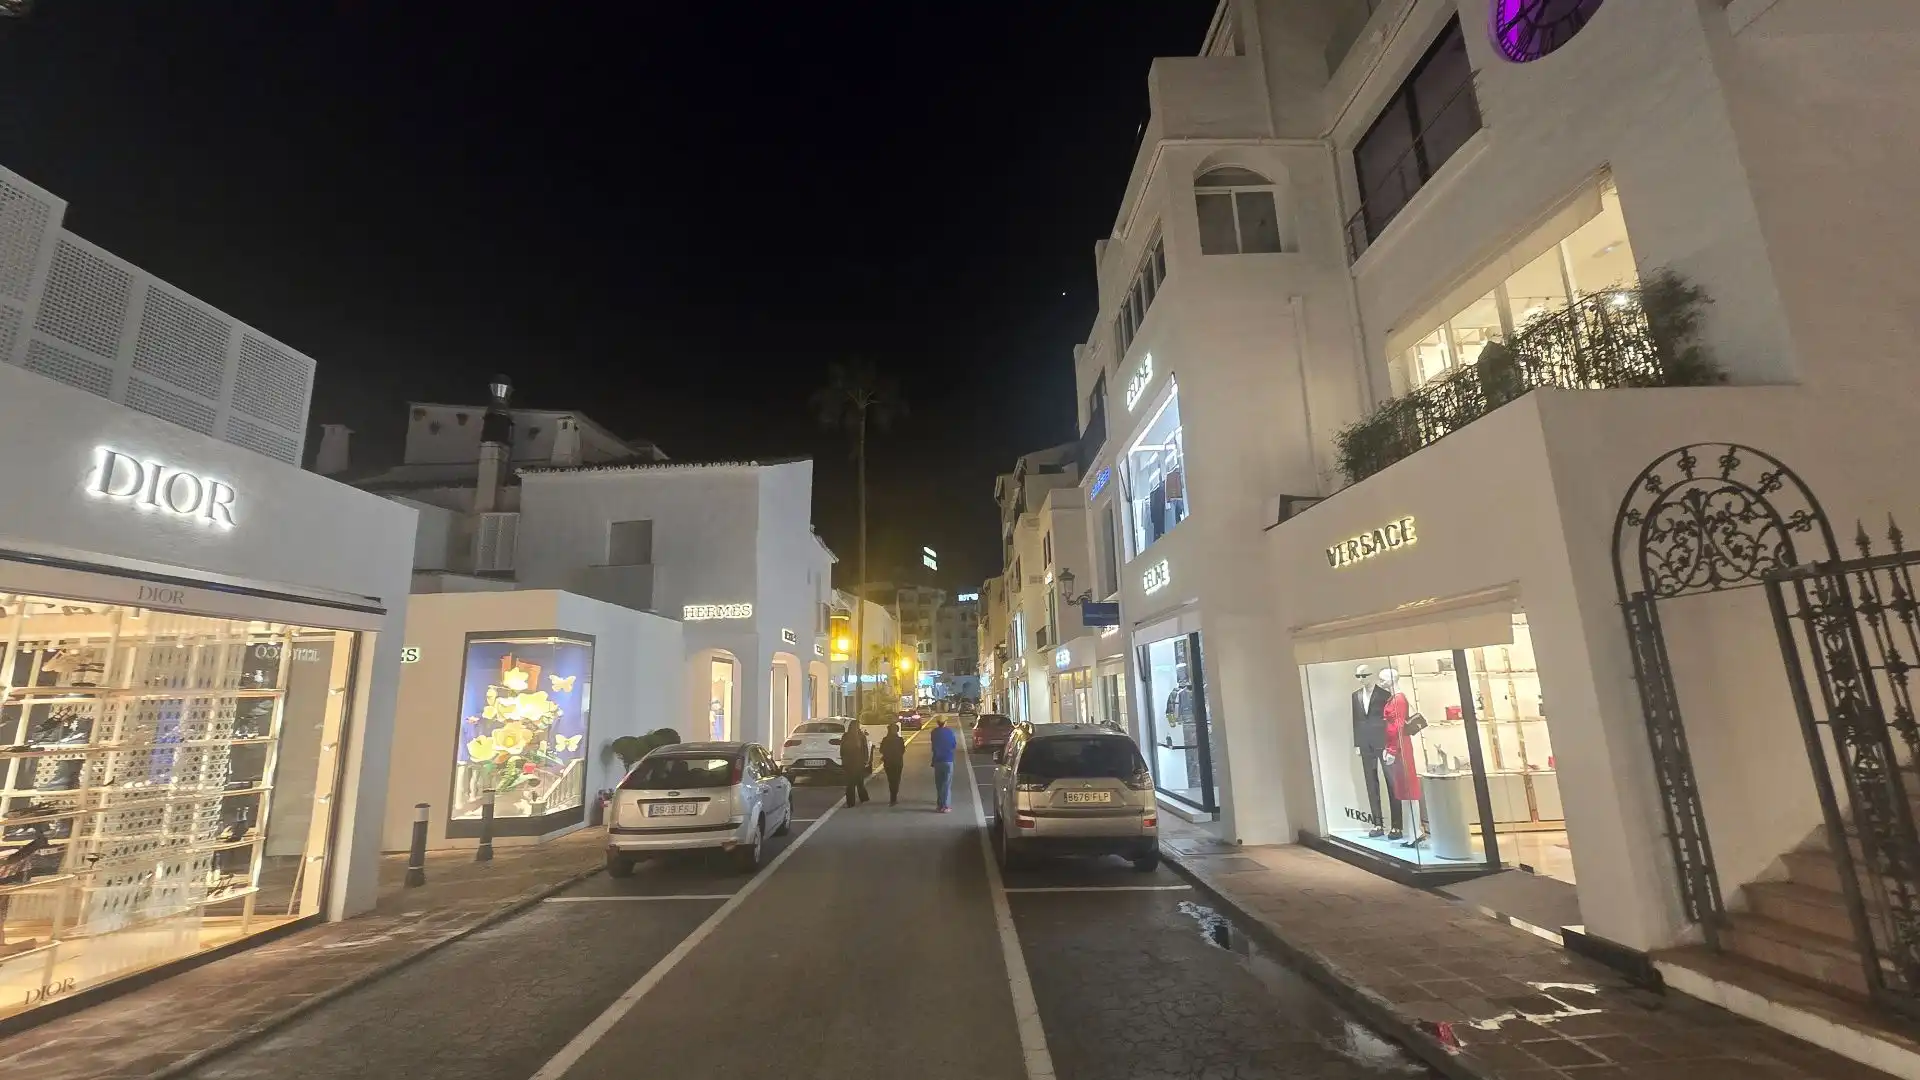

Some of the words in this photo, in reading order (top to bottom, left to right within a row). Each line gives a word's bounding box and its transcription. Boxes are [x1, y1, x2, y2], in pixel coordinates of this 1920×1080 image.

[86, 448, 236, 527] DIOR
[1325, 516, 1417, 568] VERSACE
[137, 585, 185, 605] DIOR
[24, 977, 76, 1006] DIOR
